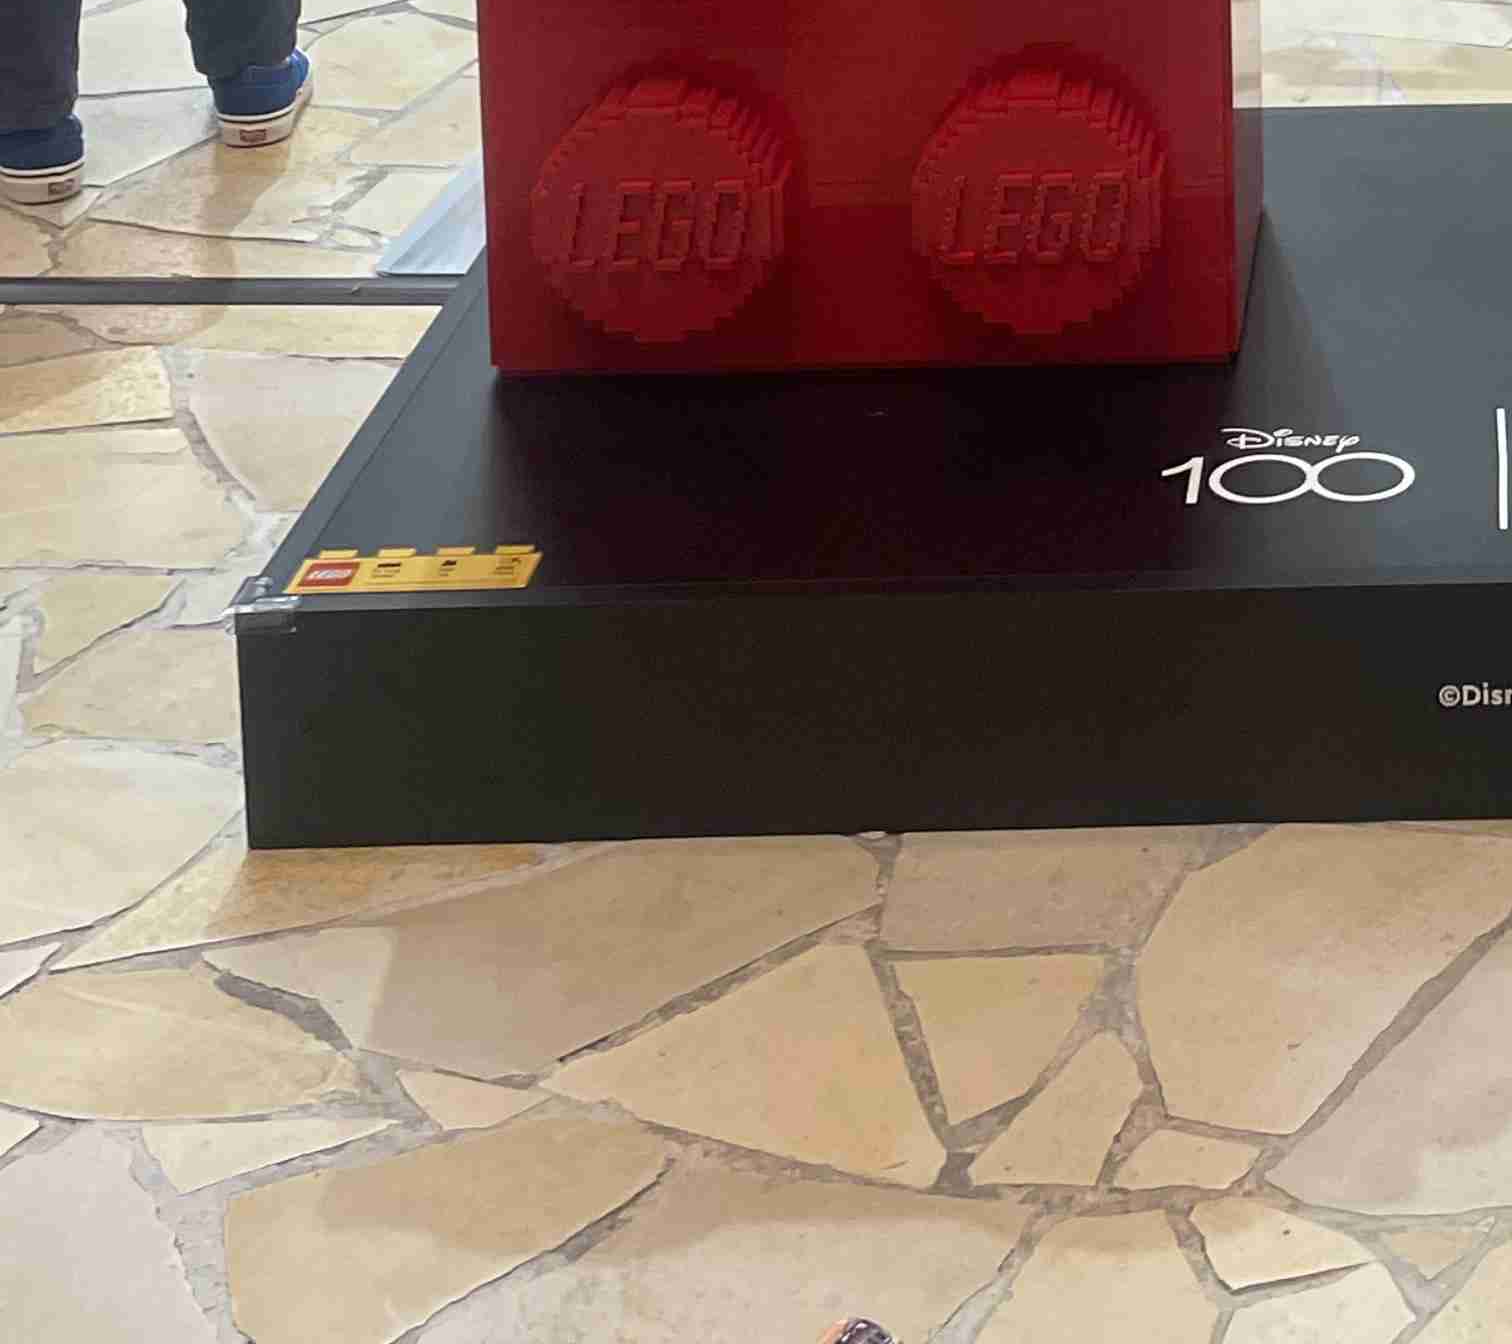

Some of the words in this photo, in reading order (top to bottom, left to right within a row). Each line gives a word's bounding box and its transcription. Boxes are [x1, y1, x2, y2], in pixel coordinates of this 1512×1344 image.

[565, 178, 753, 273] LEGO
[941, 170, 1131, 266] LEGO
[1220, 427, 1361, 454] Disney
[1160, 451, 1416, 505] 100
